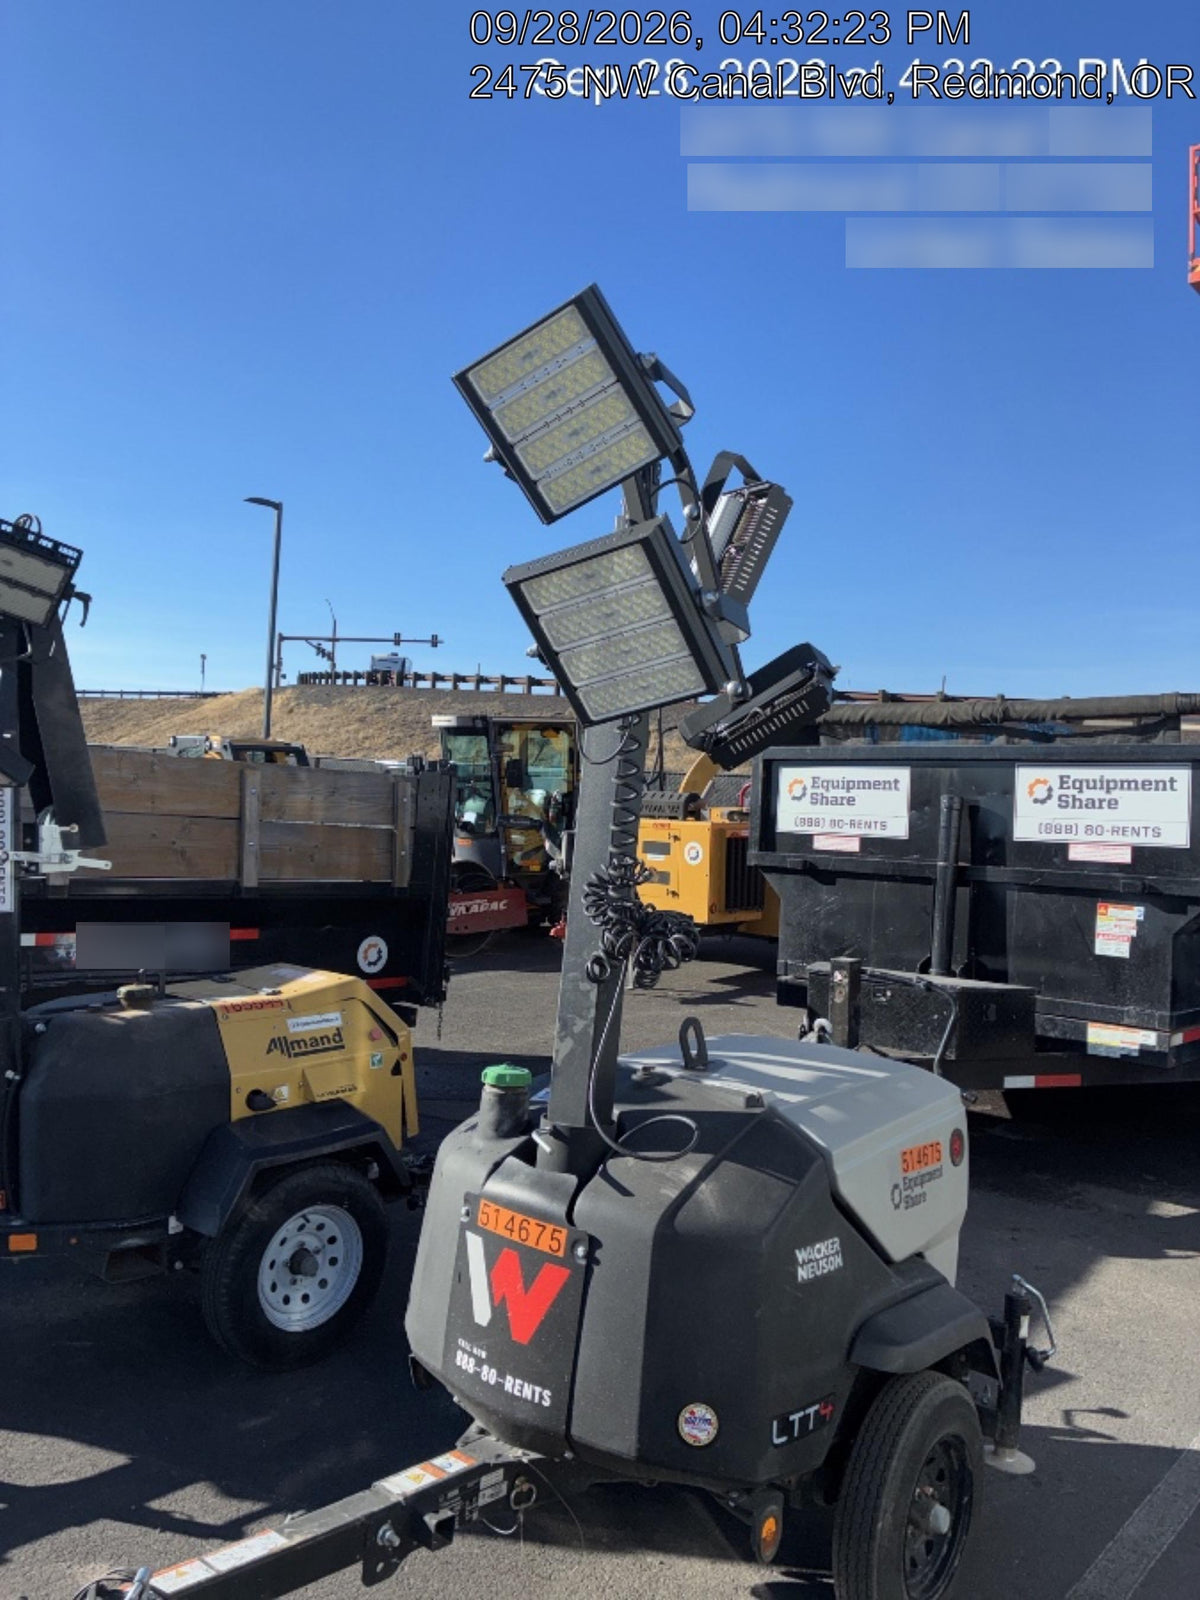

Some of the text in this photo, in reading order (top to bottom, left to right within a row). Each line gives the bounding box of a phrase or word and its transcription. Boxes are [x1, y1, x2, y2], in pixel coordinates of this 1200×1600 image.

[810, 776, 901, 793] Equipment
[1057, 774, 1178, 794] Equipment
[810, 792, 856, 806] Share
[1057, 794, 1120, 810] Share
[1084, 824, 1162, 839] 80-RENTS
[266, 1026, 344, 1059] Allmand
[902, 1142, 942, 1173] 514675
[478, 1202, 565, 1254] 514675
[795, 1236, 841, 1265] WACKER
[797, 1255, 844, 1283] NEUSON
[455, 1349, 552, 1407] 888-80-RENTS
[772, 1402, 834, 1445] LTT4
